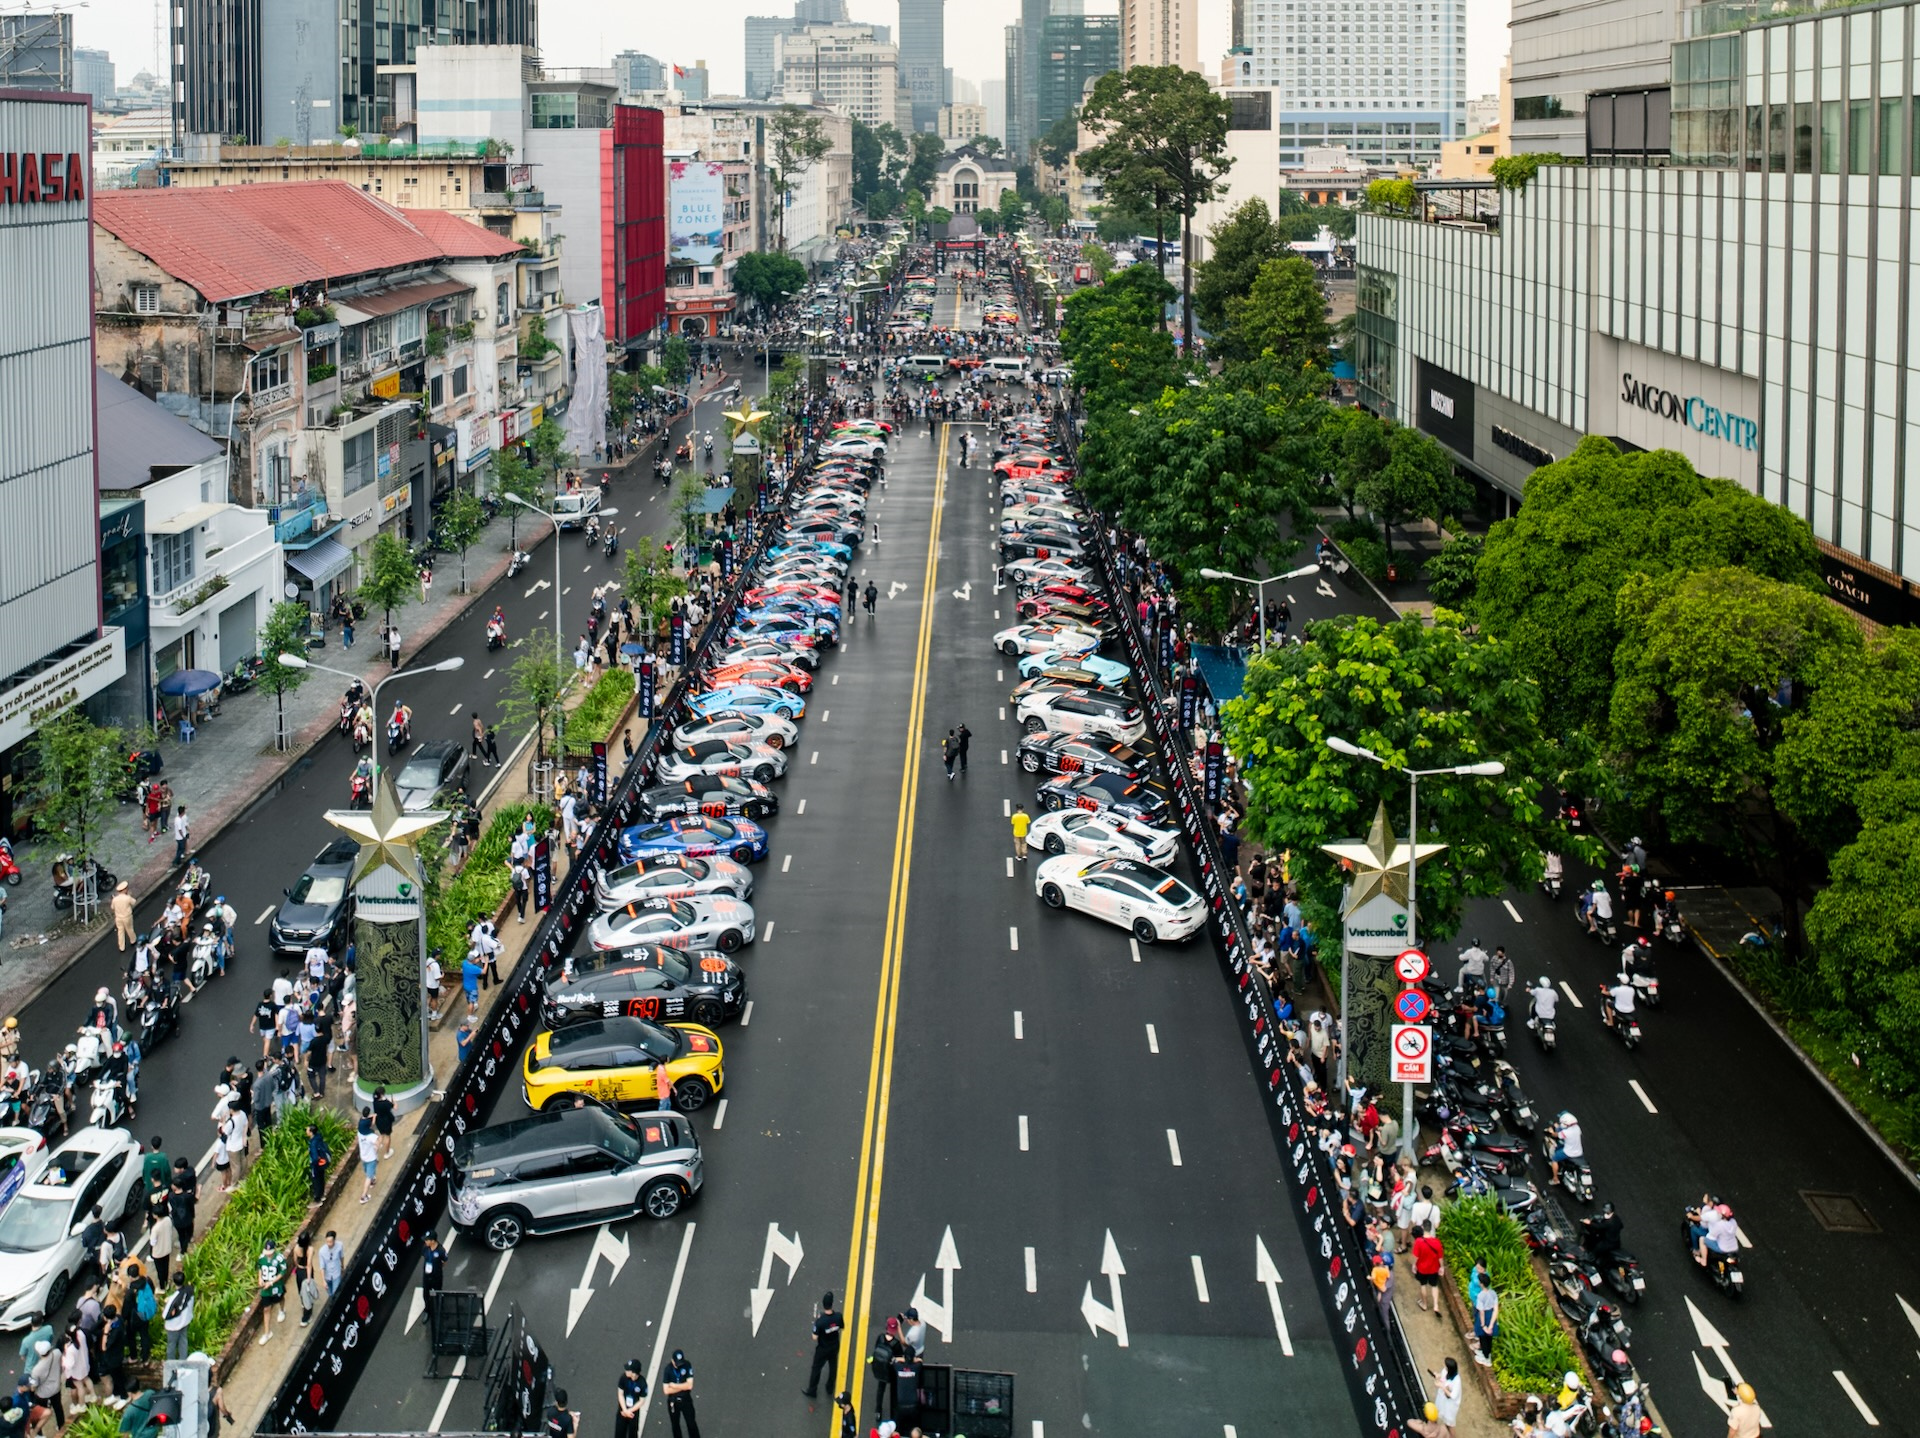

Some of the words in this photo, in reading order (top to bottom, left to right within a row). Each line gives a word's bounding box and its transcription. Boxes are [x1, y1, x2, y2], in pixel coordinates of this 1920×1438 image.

[912, 68, 929, 78] FOR
[0, 152, 84, 205] HASA
[682, 204, 712, 213] BLUE
[677, 215, 717, 224] ZONES
[1826, 575, 1870, 605] COACH
[1060, 755, 1082, 772] 87
[357, 895, 418, 906] Vietcombank
[1147, 903, 1164, 913] Hard
[1164, 907, 1180, 918] Rock
[1348, 927, 1408, 937] Vietcomban
[557, 994, 577, 1004] Hard
[577, 992, 597, 1004] Rock
[627, 995, 659, 1020] 69
[261, 1265, 278, 1282] 92
